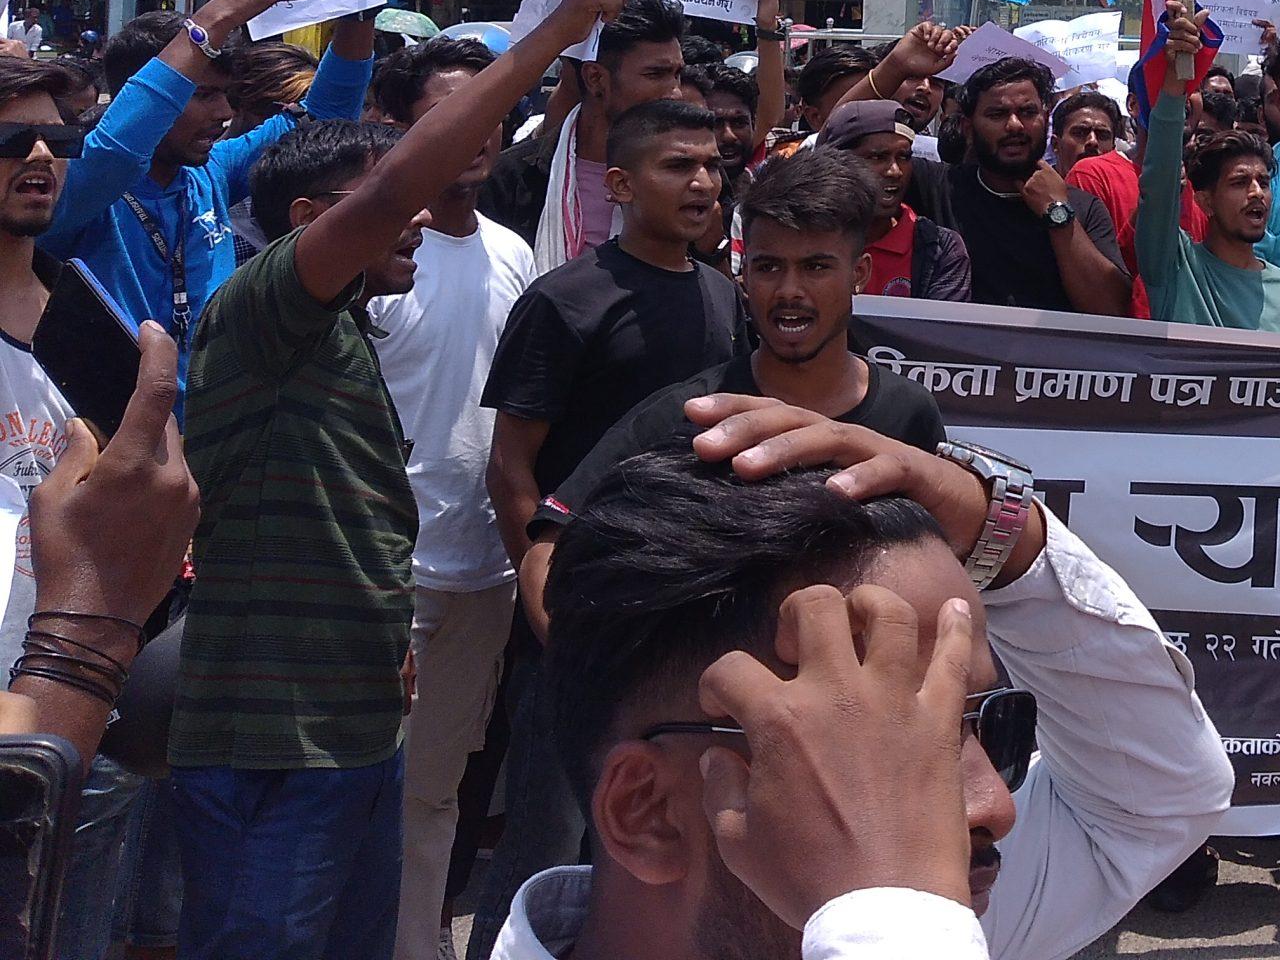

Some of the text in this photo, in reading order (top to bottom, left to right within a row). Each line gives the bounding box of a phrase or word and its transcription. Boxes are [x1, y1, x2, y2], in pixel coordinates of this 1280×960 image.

[1014, 366, 1138, 403] प्रमाण
[1150, 373, 1218, 407] पत्र
[1205, 634, 1237, 662] २२
